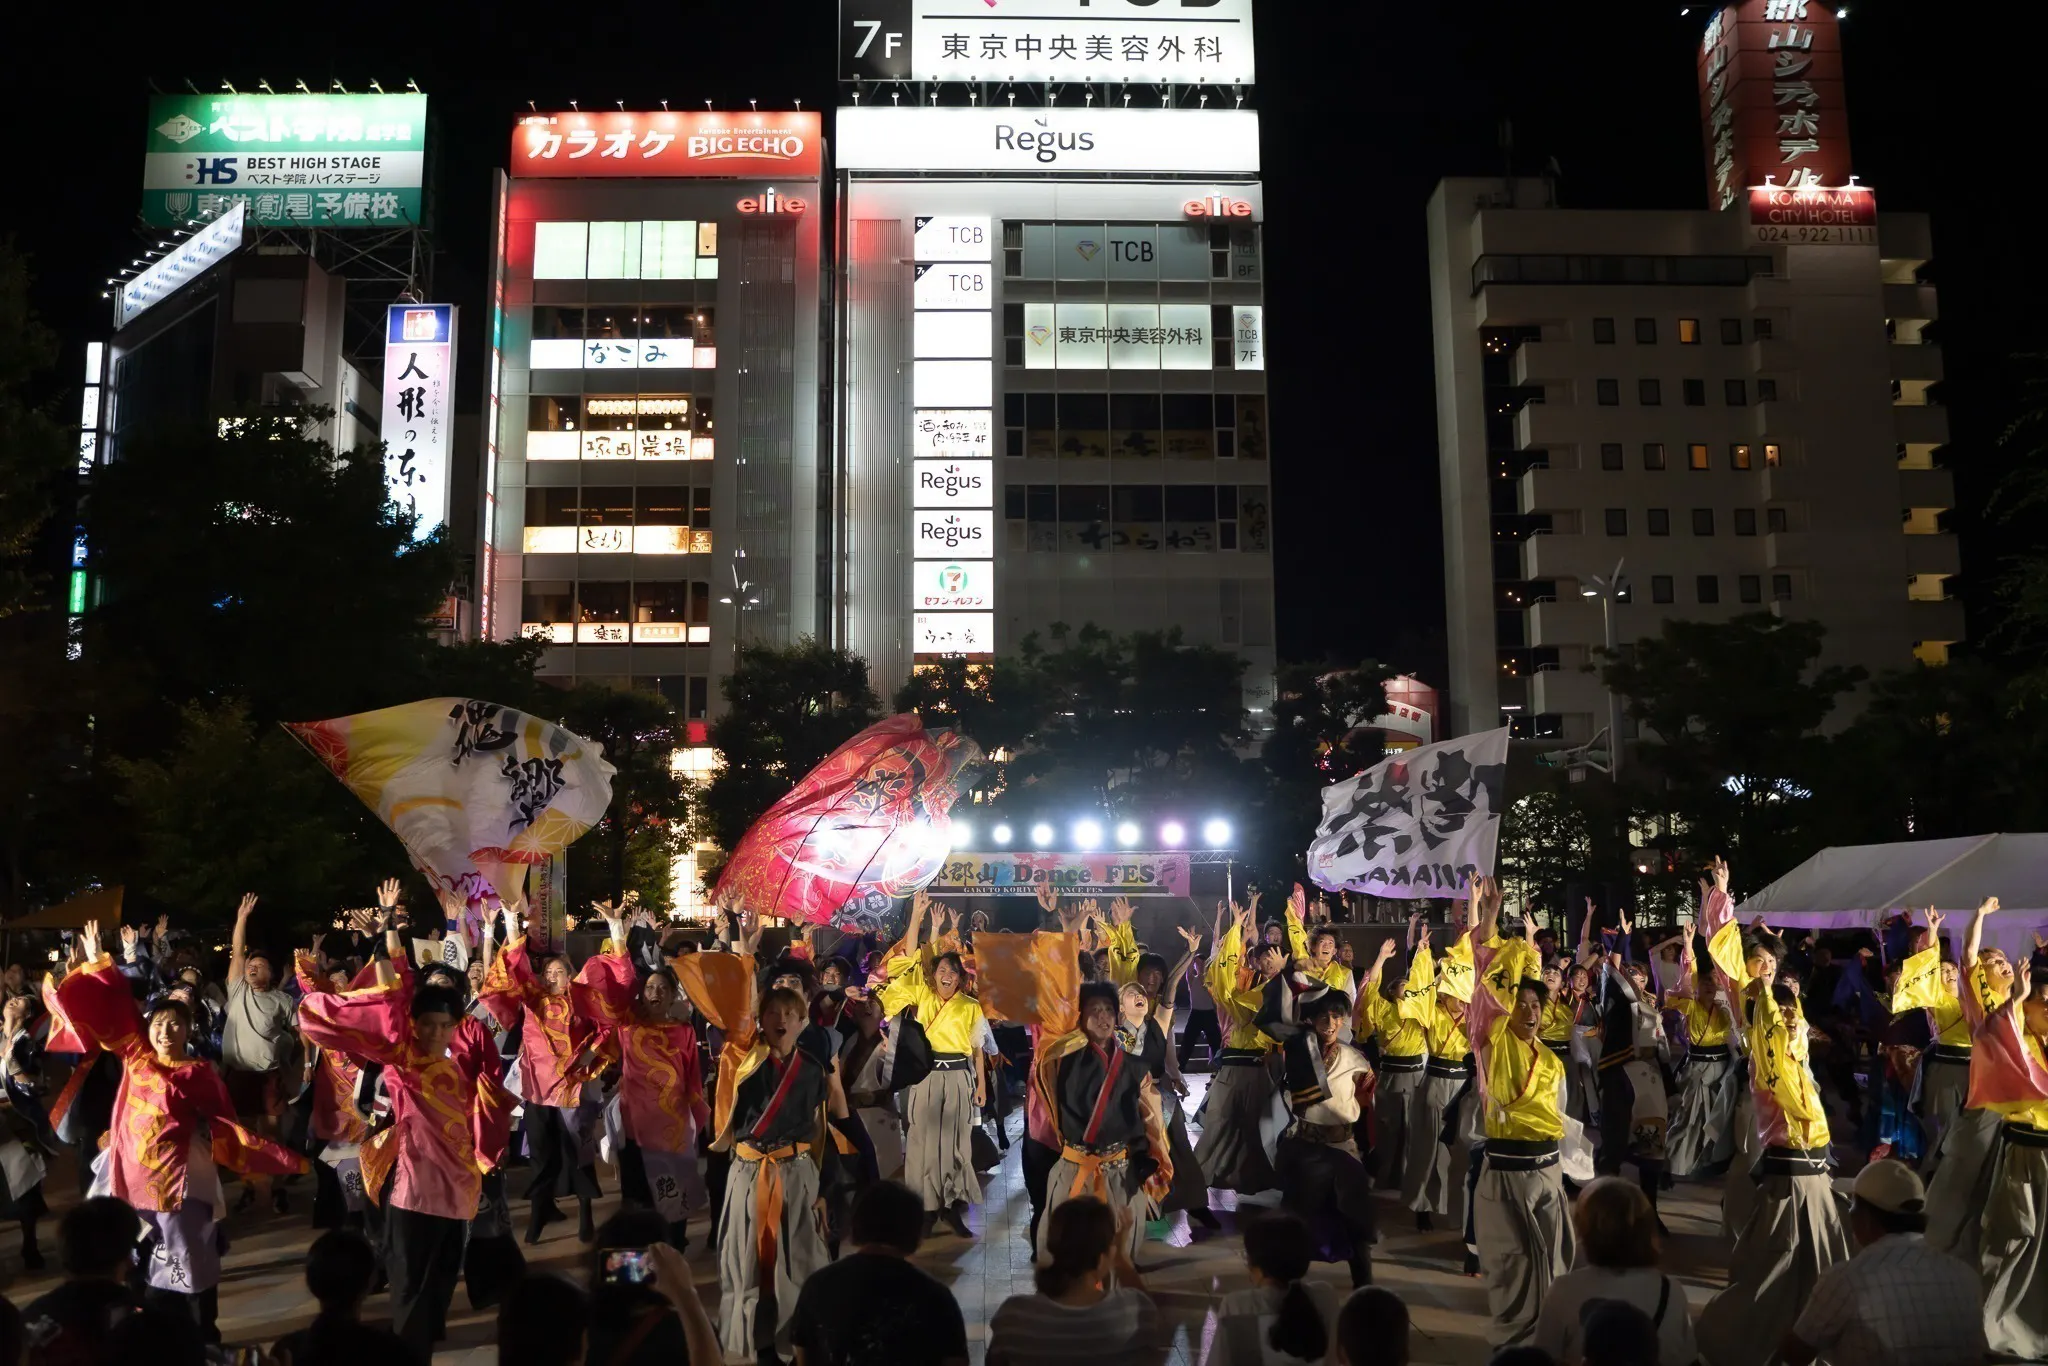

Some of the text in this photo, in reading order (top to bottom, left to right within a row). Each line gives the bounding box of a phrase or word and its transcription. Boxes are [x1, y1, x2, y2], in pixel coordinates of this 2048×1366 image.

[853, 20, 902, 59] 7F
[941, 33, 1222, 62] 東京中央美容外科
[734, 127, 792, 135] Entertainment
[527, 130, 675, 159] カラオケ
[688, 136, 804, 158] BIG ECHO
[995, 122, 1095, 163] Regus
[247, 157, 381, 169] BEST HIGH STAGE
[247, 173, 381, 185] ベスト学院 ハイステージ
[736, 187, 806, 214] elite
[1184, 187, 1252, 217] elite
[1768, 191, 1855, 206] KORIYAMA
[1769, 209, 1858, 224] CITY HOTEL
[949, 227, 983, 244] TCB
[1758, 227, 1874, 242] 024-922-1111
[1110, 240, 1154, 262] TCB
[949, 275, 984, 292] TCB
[1058, 327, 1203, 345] 東京中央美容外科
[1239, 329, 1258, 340] TCB
[1241, 350, 1257, 362] 7F
[921, 470, 982, 497] Regus
[921, 521, 982, 548] Regus
[1013, 863, 1092, 883] Dance
[1105, 863, 1155, 884] FES
[964, 886, 1001, 894] GAKUTO
[1003, 886, 1042, 894] KORIYA
